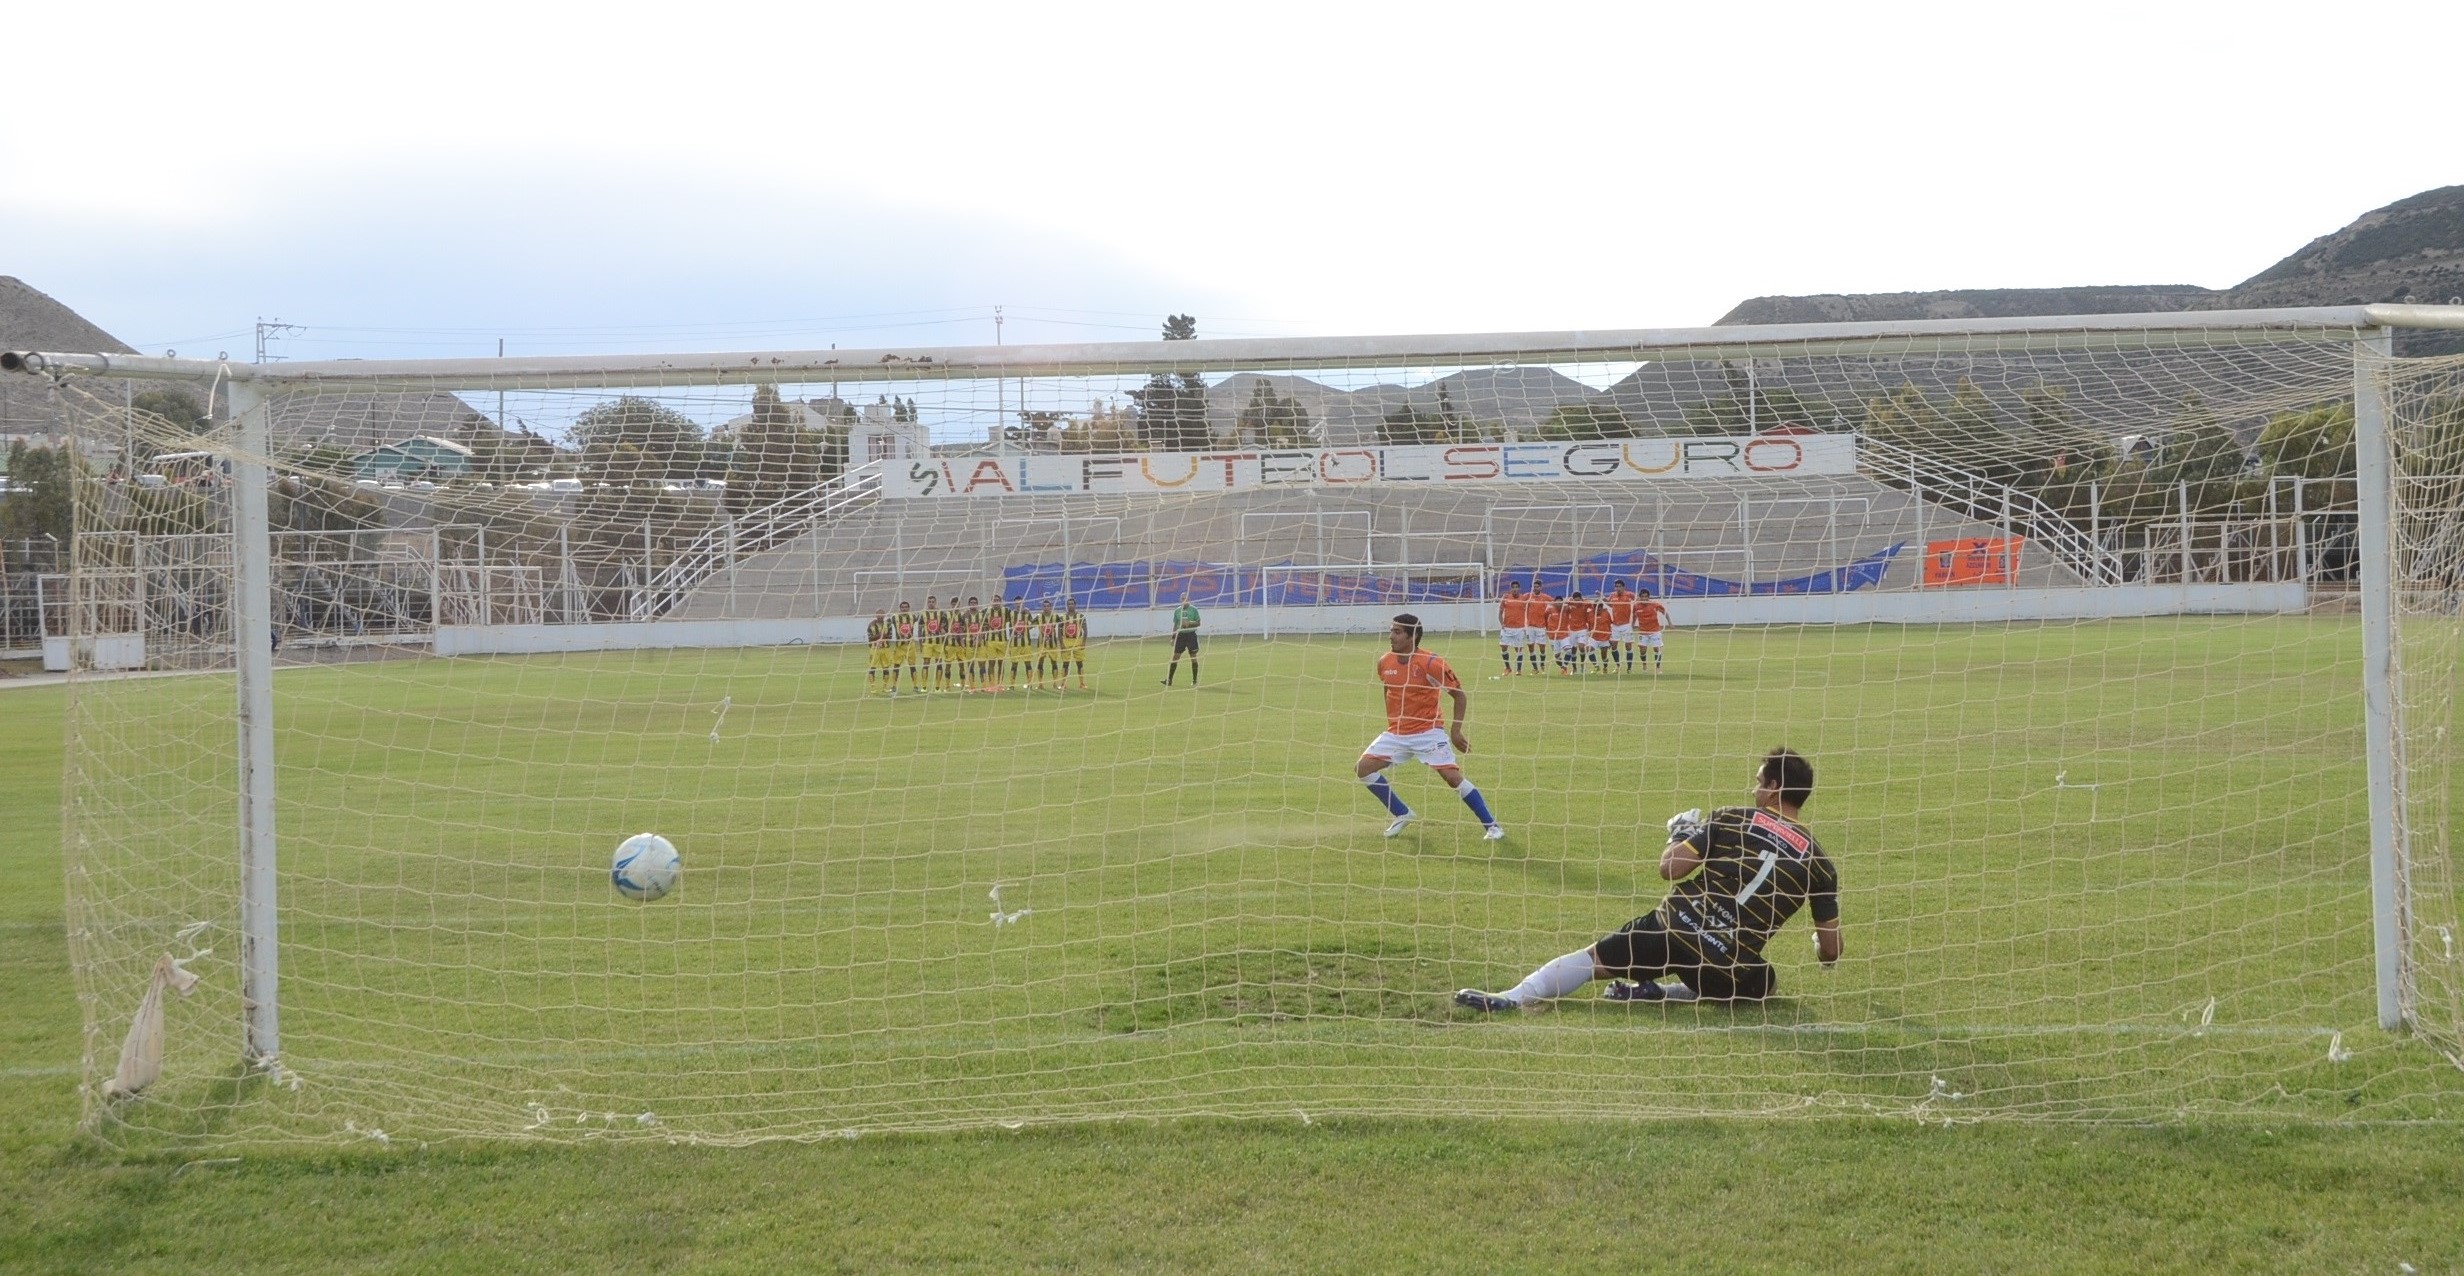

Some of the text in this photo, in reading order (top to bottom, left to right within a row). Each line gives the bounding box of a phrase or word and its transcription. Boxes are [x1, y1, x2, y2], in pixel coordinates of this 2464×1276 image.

[963, 458, 1073, 494] AL
[1082, 449, 1430, 491] FUTBOL
[1443, 438, 1803, 480] SEGURO
[1736, 849, 1778, 905] 1
